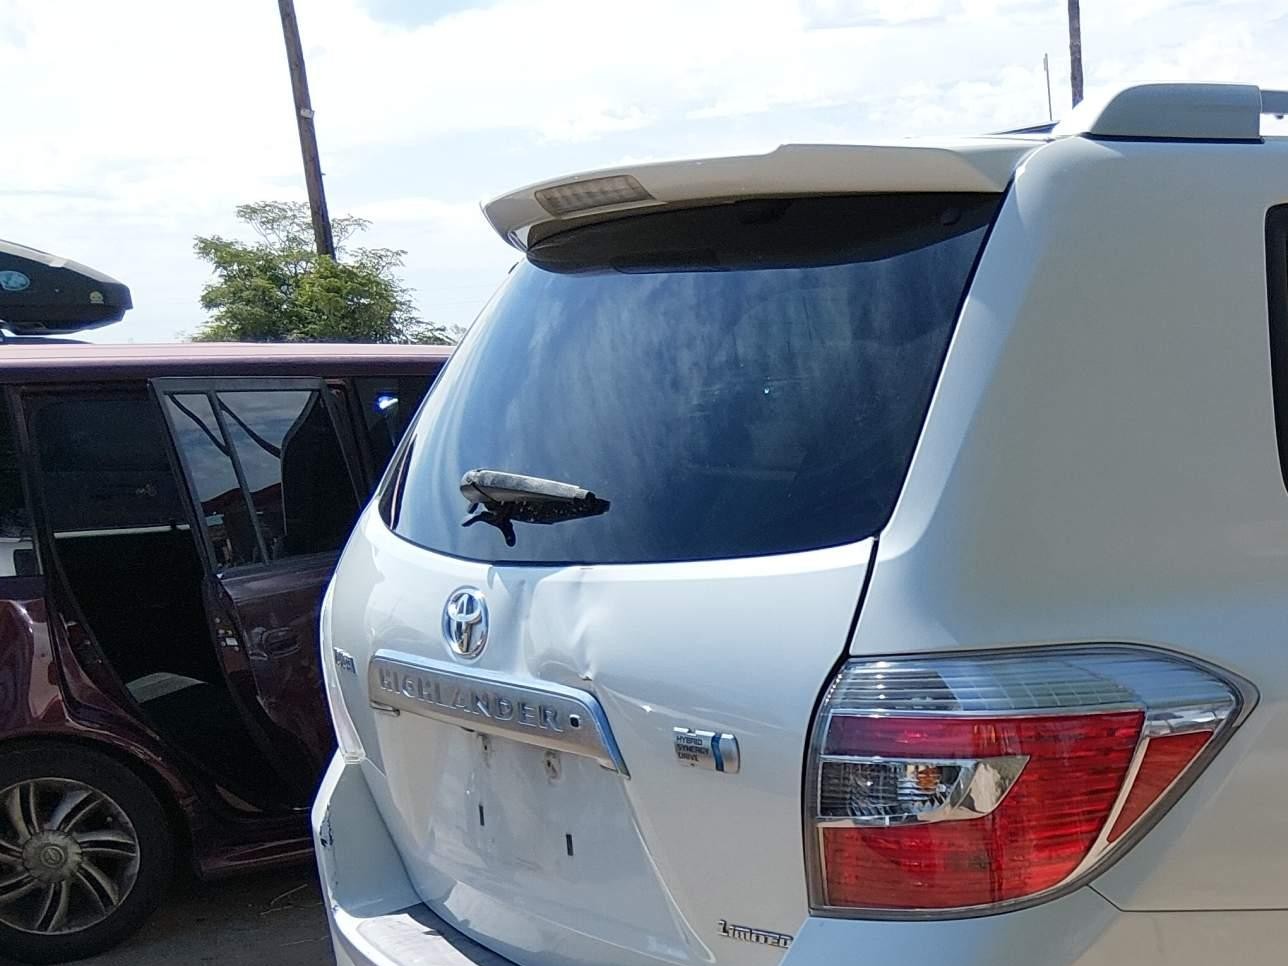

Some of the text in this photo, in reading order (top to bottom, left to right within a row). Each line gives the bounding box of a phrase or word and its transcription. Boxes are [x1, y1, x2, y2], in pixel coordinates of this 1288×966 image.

[379, 668, 564, 733] HIGHLANDER
[676, 735, 703, 746] HYBRID
[678, 752, 699, 761] DRIVE
